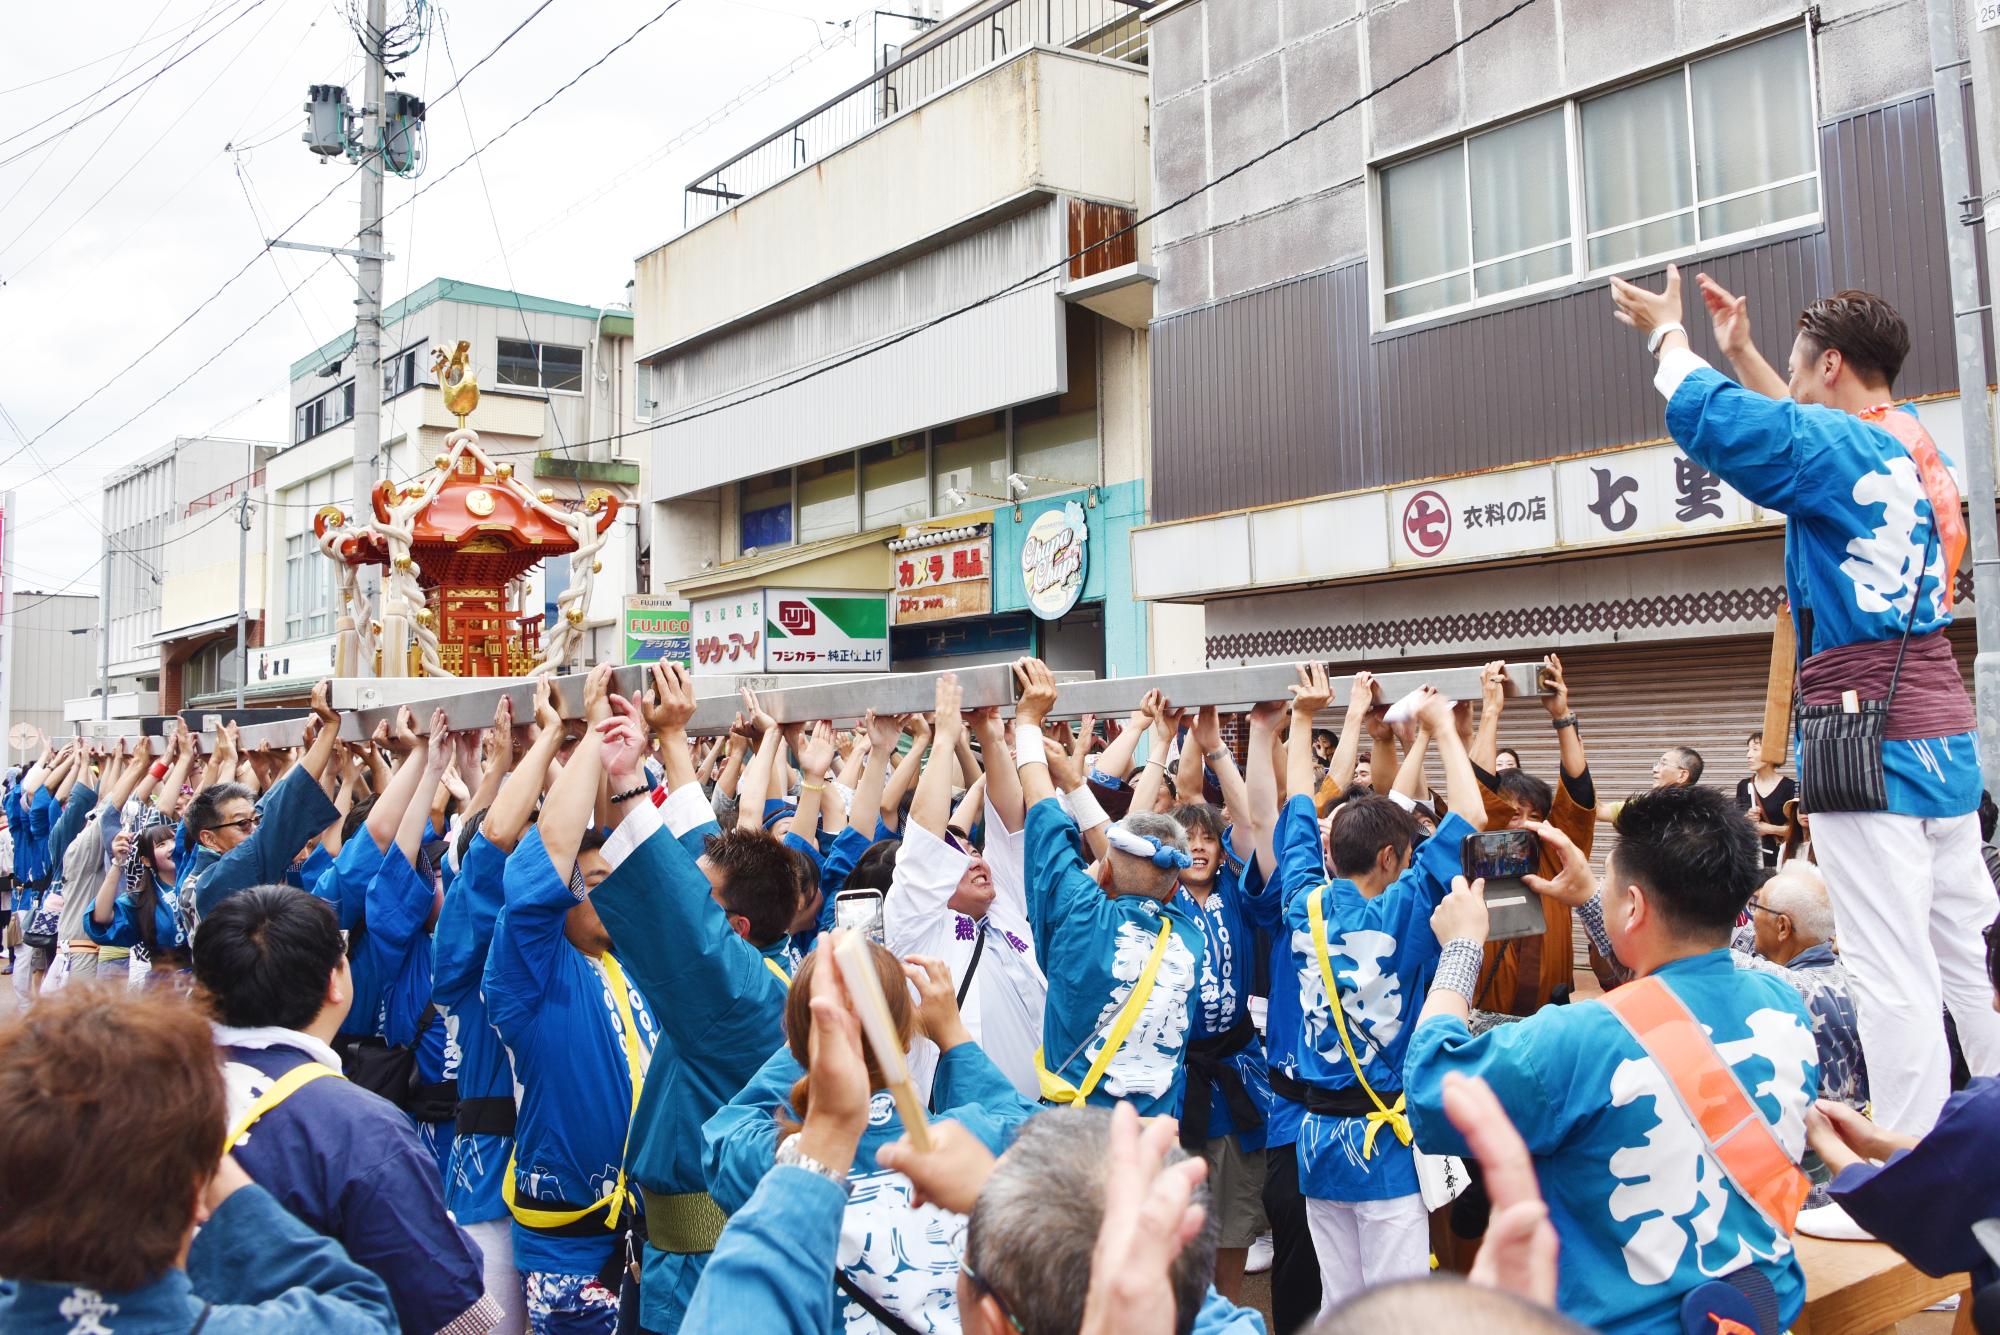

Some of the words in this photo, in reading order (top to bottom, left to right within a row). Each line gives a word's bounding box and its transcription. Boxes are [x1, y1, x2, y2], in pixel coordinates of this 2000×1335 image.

[1981, 5, 2000, 23] 25
[1463, 496, 1546, 529] 衣料の店
[899, 555, 944, 587] カメラ
[953, 549, 983, 578] 用品
